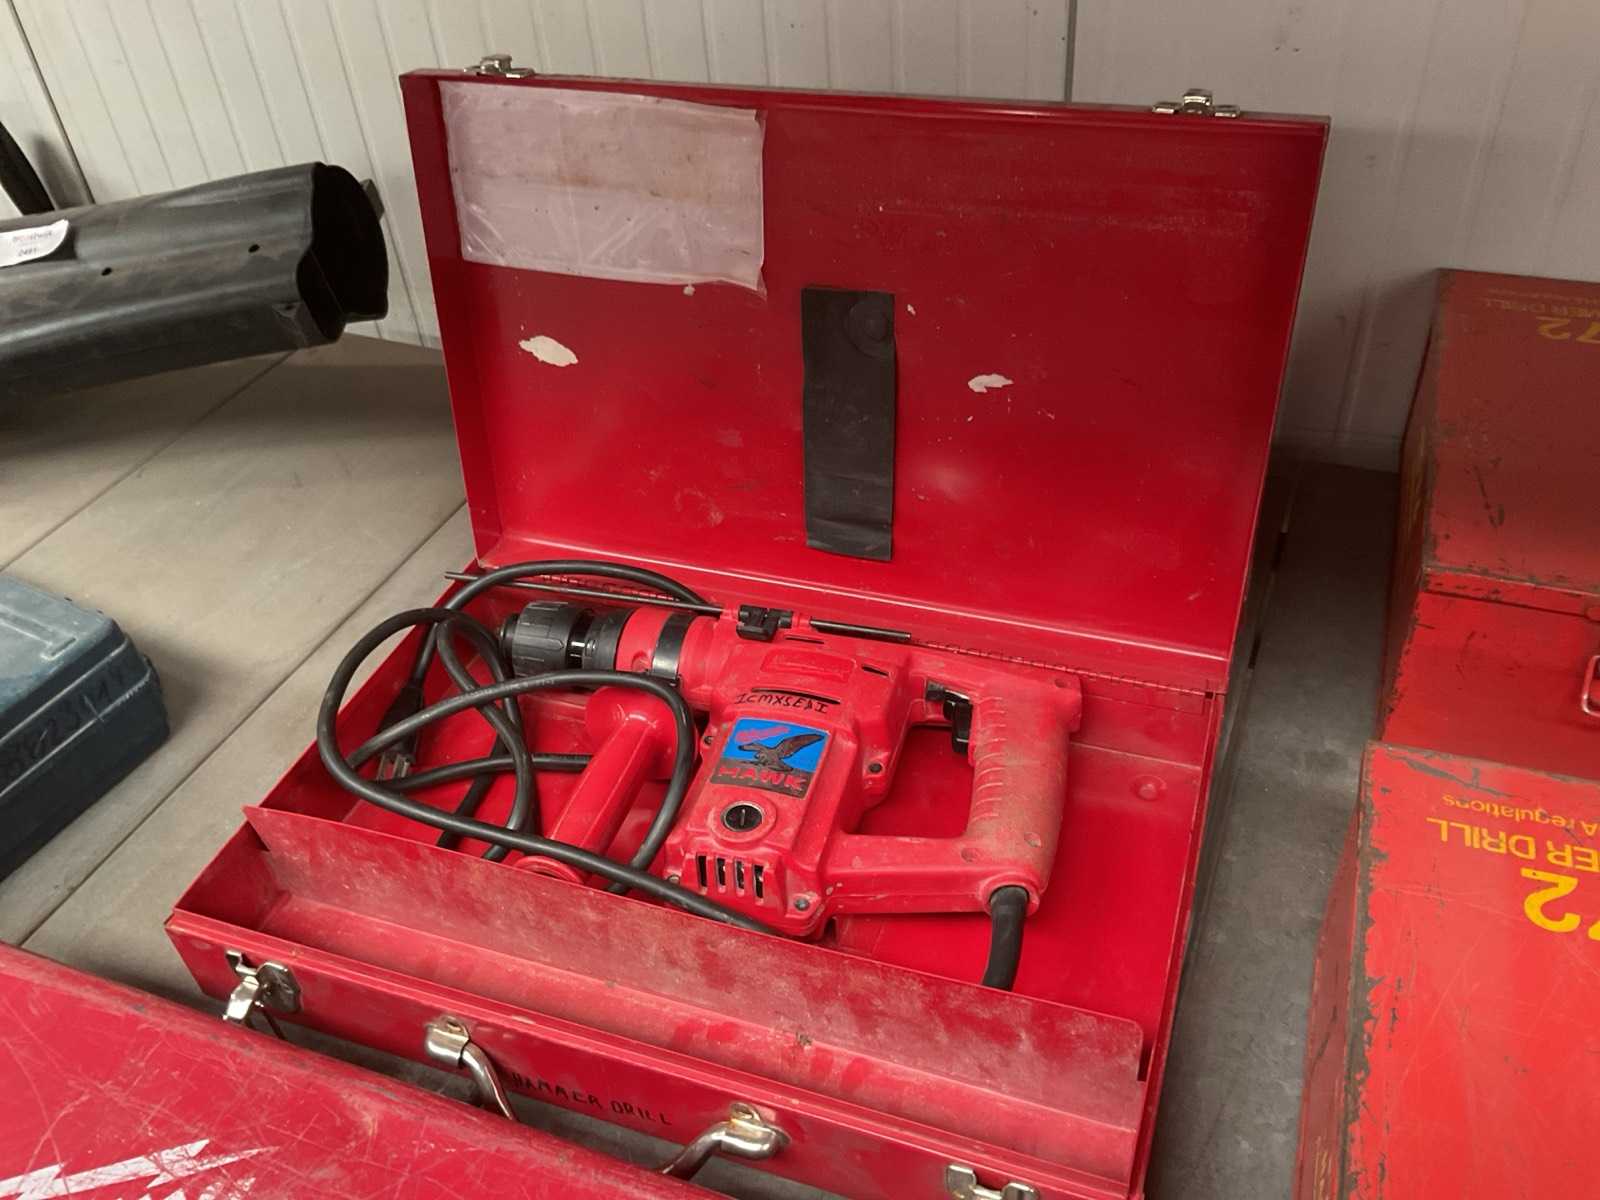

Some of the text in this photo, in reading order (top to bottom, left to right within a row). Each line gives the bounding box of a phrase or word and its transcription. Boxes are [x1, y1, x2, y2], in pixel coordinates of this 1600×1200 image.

[719, 767, 807, 791] HAWK
[1426, 817, 1537, 860] DRILL
[511, 1071, 673, 1127] HAMMER DRILL
